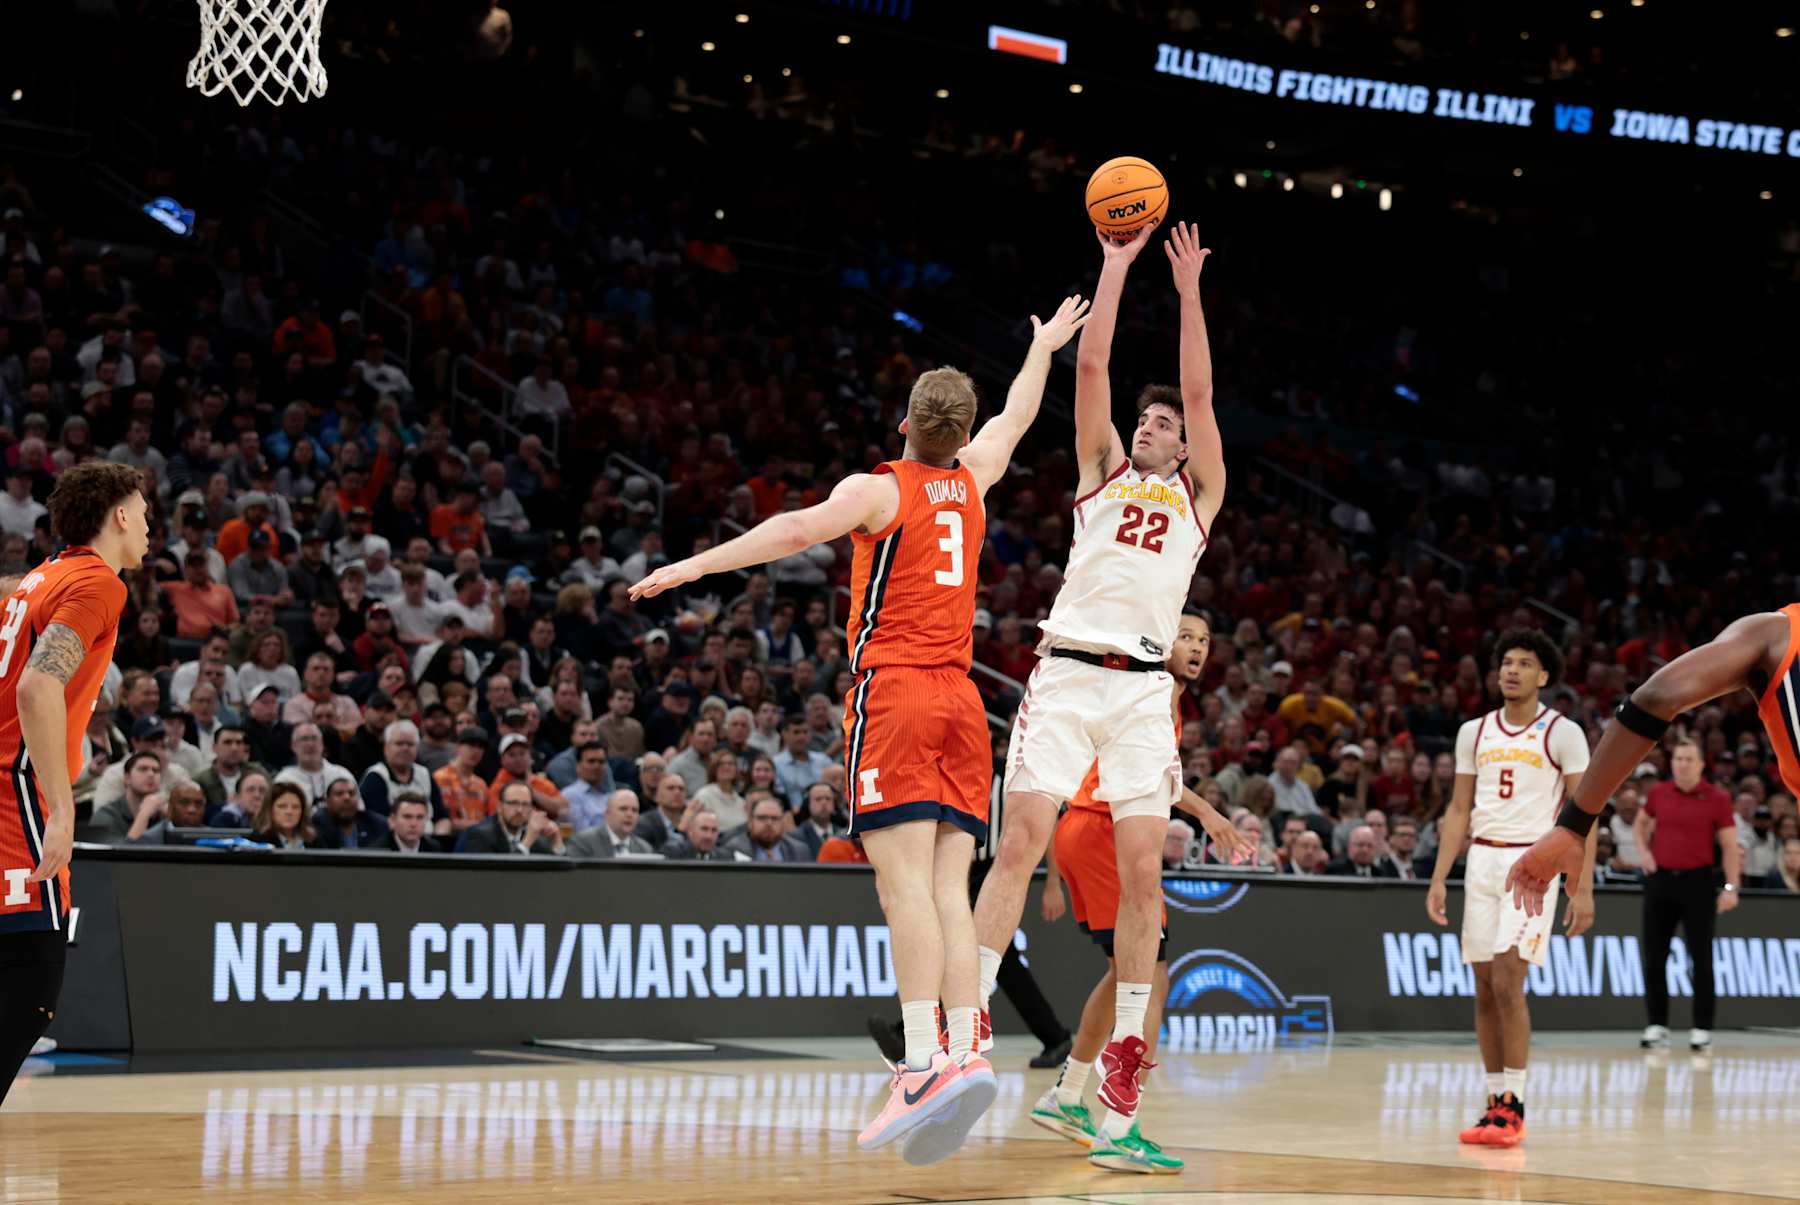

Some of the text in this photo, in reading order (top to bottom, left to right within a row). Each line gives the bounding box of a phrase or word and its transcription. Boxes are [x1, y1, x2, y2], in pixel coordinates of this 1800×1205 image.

[1154, 42, 1275, 95] ILLINOIS
[1276, 66, 1429, 116] FIGHTING
[1433, 87, 1537, 128] ILLINI
[1553, 103, 1594, 136] VS
[1609, 107, 1691, 145] IOWA
[1695, 117, 1784, 157] STATE
[1107, 199, 1146, 219] NCAA
[934, 510, 964, 587] 3
[1115, 504, 1169, 554] 22
[859, 767, 884, 806] I
[1498, 767, 1514, 799] 5
[4, 868, 32, 906] I
[212, 921, 1028, 1002] NCAA.COM/MARCHMAD
